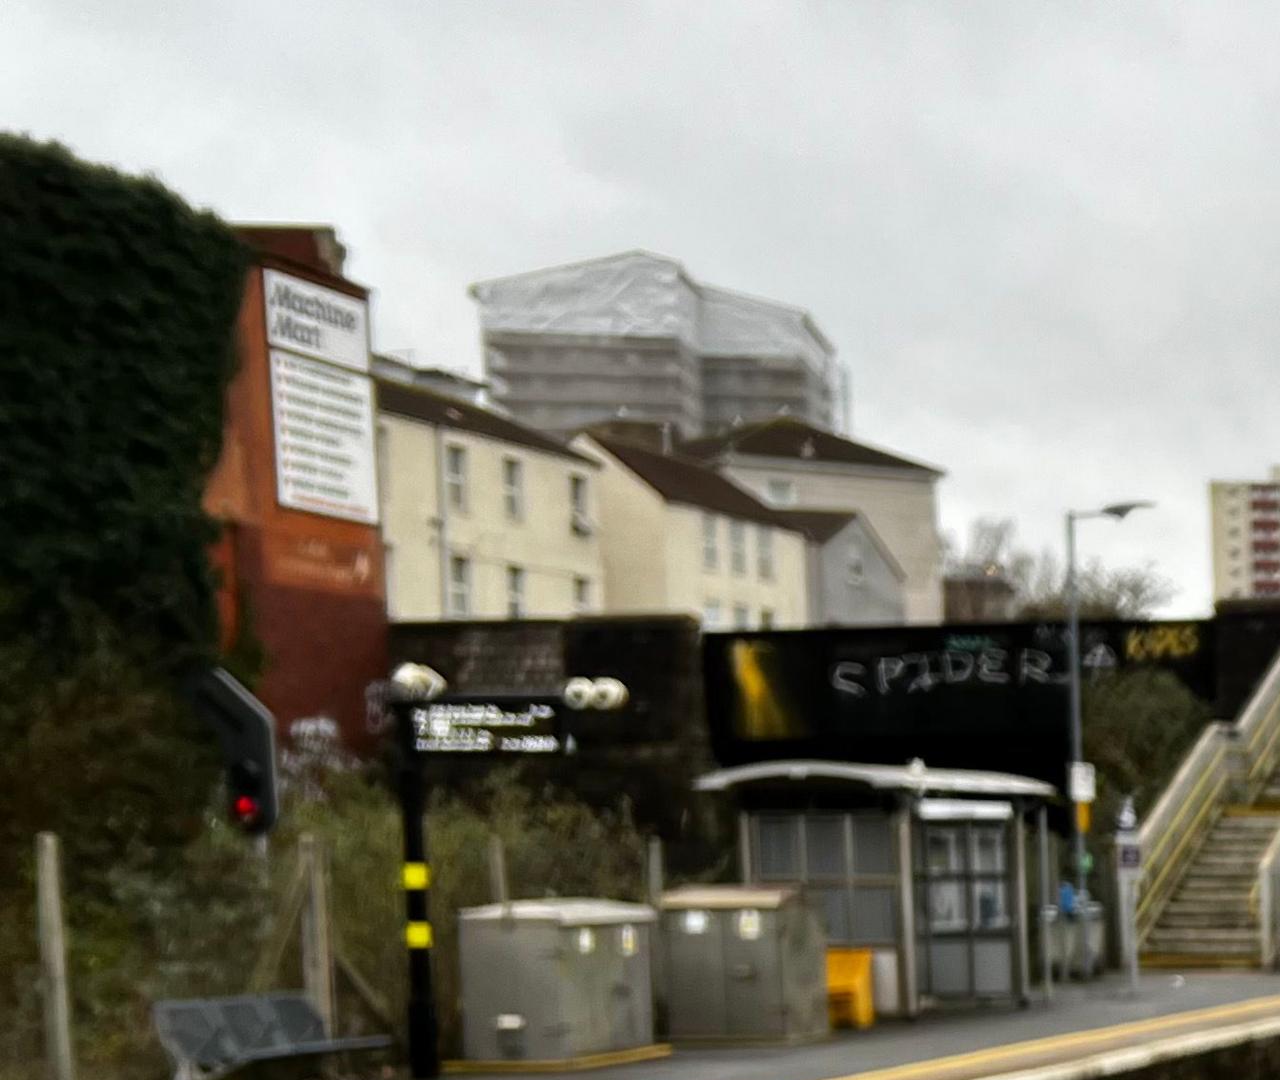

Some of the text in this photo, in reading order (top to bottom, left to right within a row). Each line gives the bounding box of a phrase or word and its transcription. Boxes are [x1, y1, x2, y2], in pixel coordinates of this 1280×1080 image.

[270, 283, 356, 330] Machine
[272, 313, 320, 347] Mart
[830, 647, 1060, 697] SPIDER
